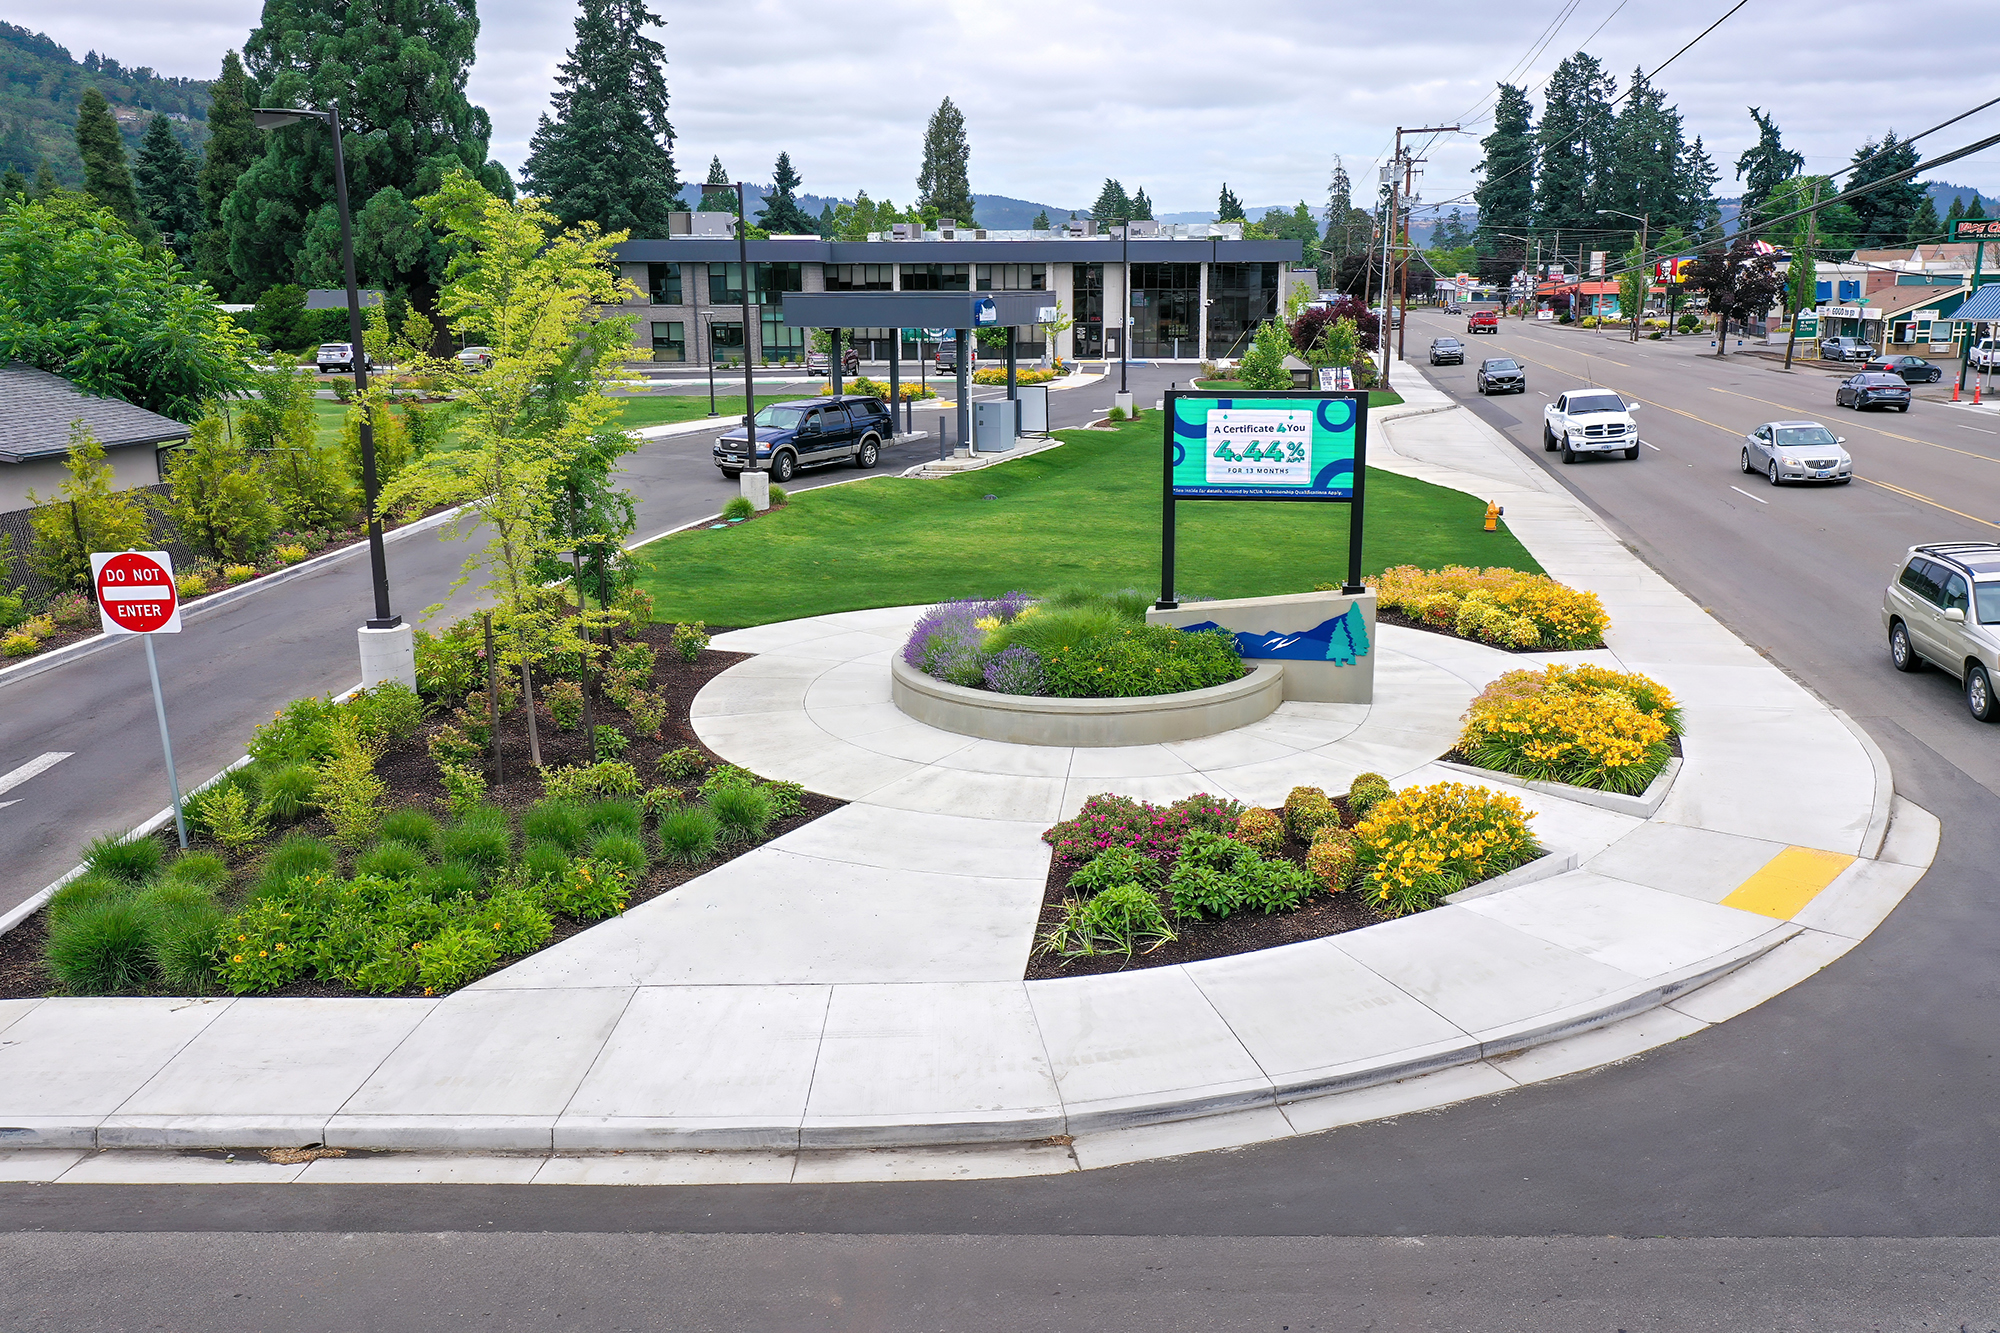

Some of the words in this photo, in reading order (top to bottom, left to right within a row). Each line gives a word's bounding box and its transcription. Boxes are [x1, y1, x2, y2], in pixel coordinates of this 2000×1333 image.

[1213, 425, 1221, 433] A
[1223, 424, 1275, 434] Certificate
[1276, 422, 1287, 433] 4
[1287, 424, 1306, 432] You
[1213, 440, 1306, 462] 4.44%
[105, 569, 125, 582] DO
[132, 568, 159, 581] NOT
[117, 604, 162, 617] ENTER
